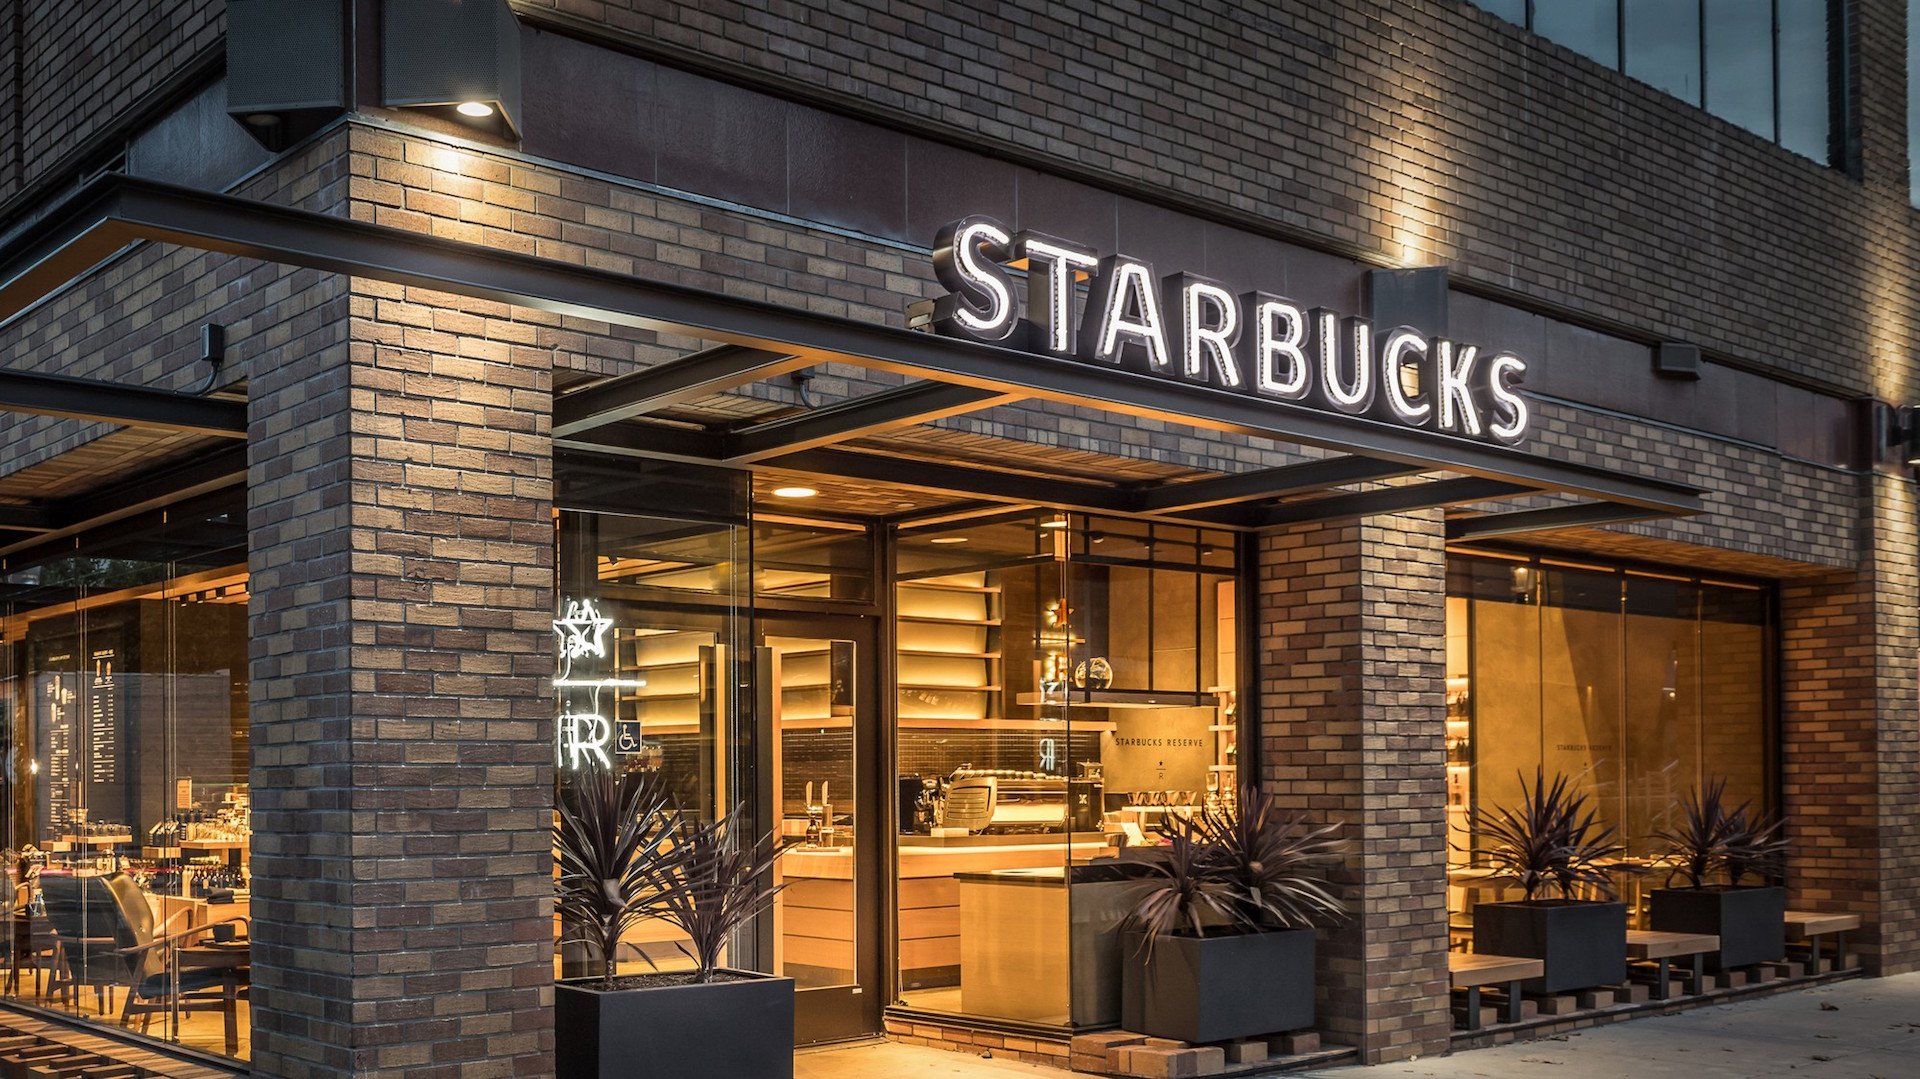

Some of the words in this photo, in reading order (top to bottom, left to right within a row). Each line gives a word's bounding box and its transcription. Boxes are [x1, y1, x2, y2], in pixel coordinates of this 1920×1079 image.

[943, 216, 1529, 445] STARBUCKS
[1115, 737, 1163, 747] STARBUCKS
[1166, 738, 1203, 748] RESERVE
